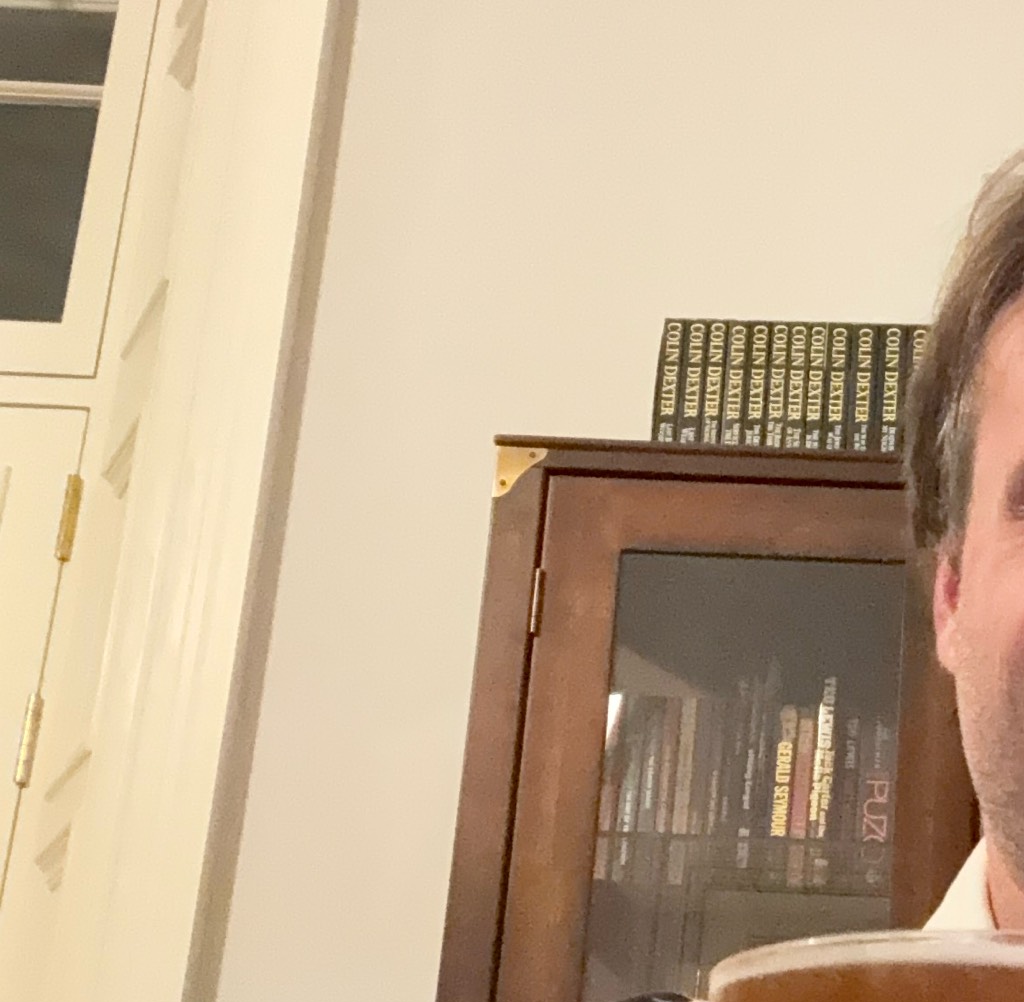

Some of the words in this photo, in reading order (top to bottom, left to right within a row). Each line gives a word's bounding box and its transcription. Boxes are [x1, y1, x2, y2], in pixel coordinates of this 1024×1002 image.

[666, 322, 682, 362] COLIN
[689, 323, 704, 363] COLIN
[710, 323, 725, 363] COLIN
[730, 326, 746, 366] COLIN
[752, 325, 768, 365] COLIN
[772, 324, 788, 366] COLIN
[791, 326, 806, 366] COLIN
[810, 327, 826, 367] COLIN
[832, 328, 847, 367] COLIN
[858, 328, 872, 368] COLIN
[885, 328, 900, 368] COLIN
[660, 366, 678, 416] DEXTER
[684, 367, 700, 418] DEXTER
[705, 366, 722, 416] DEXTER
[727, 370, 743, 420] DEXTER
[748, 369, 764, 419] DEXTER
[769, 368, 784, 419] DEXTER
[788, 370, 804, 420] DEXTER
[807, 370, 822, 421] DEXTER
[828, 371, 844, 422] DEXTER
[855, 372, 870, 422] DEXTER
[882, 372, 898, 422] DEXTER
[820, 705, 835, 749] LEWIS
[775, 741, 793, 783] GERALD
[770, 785, 791, 837] SEYMOUR
